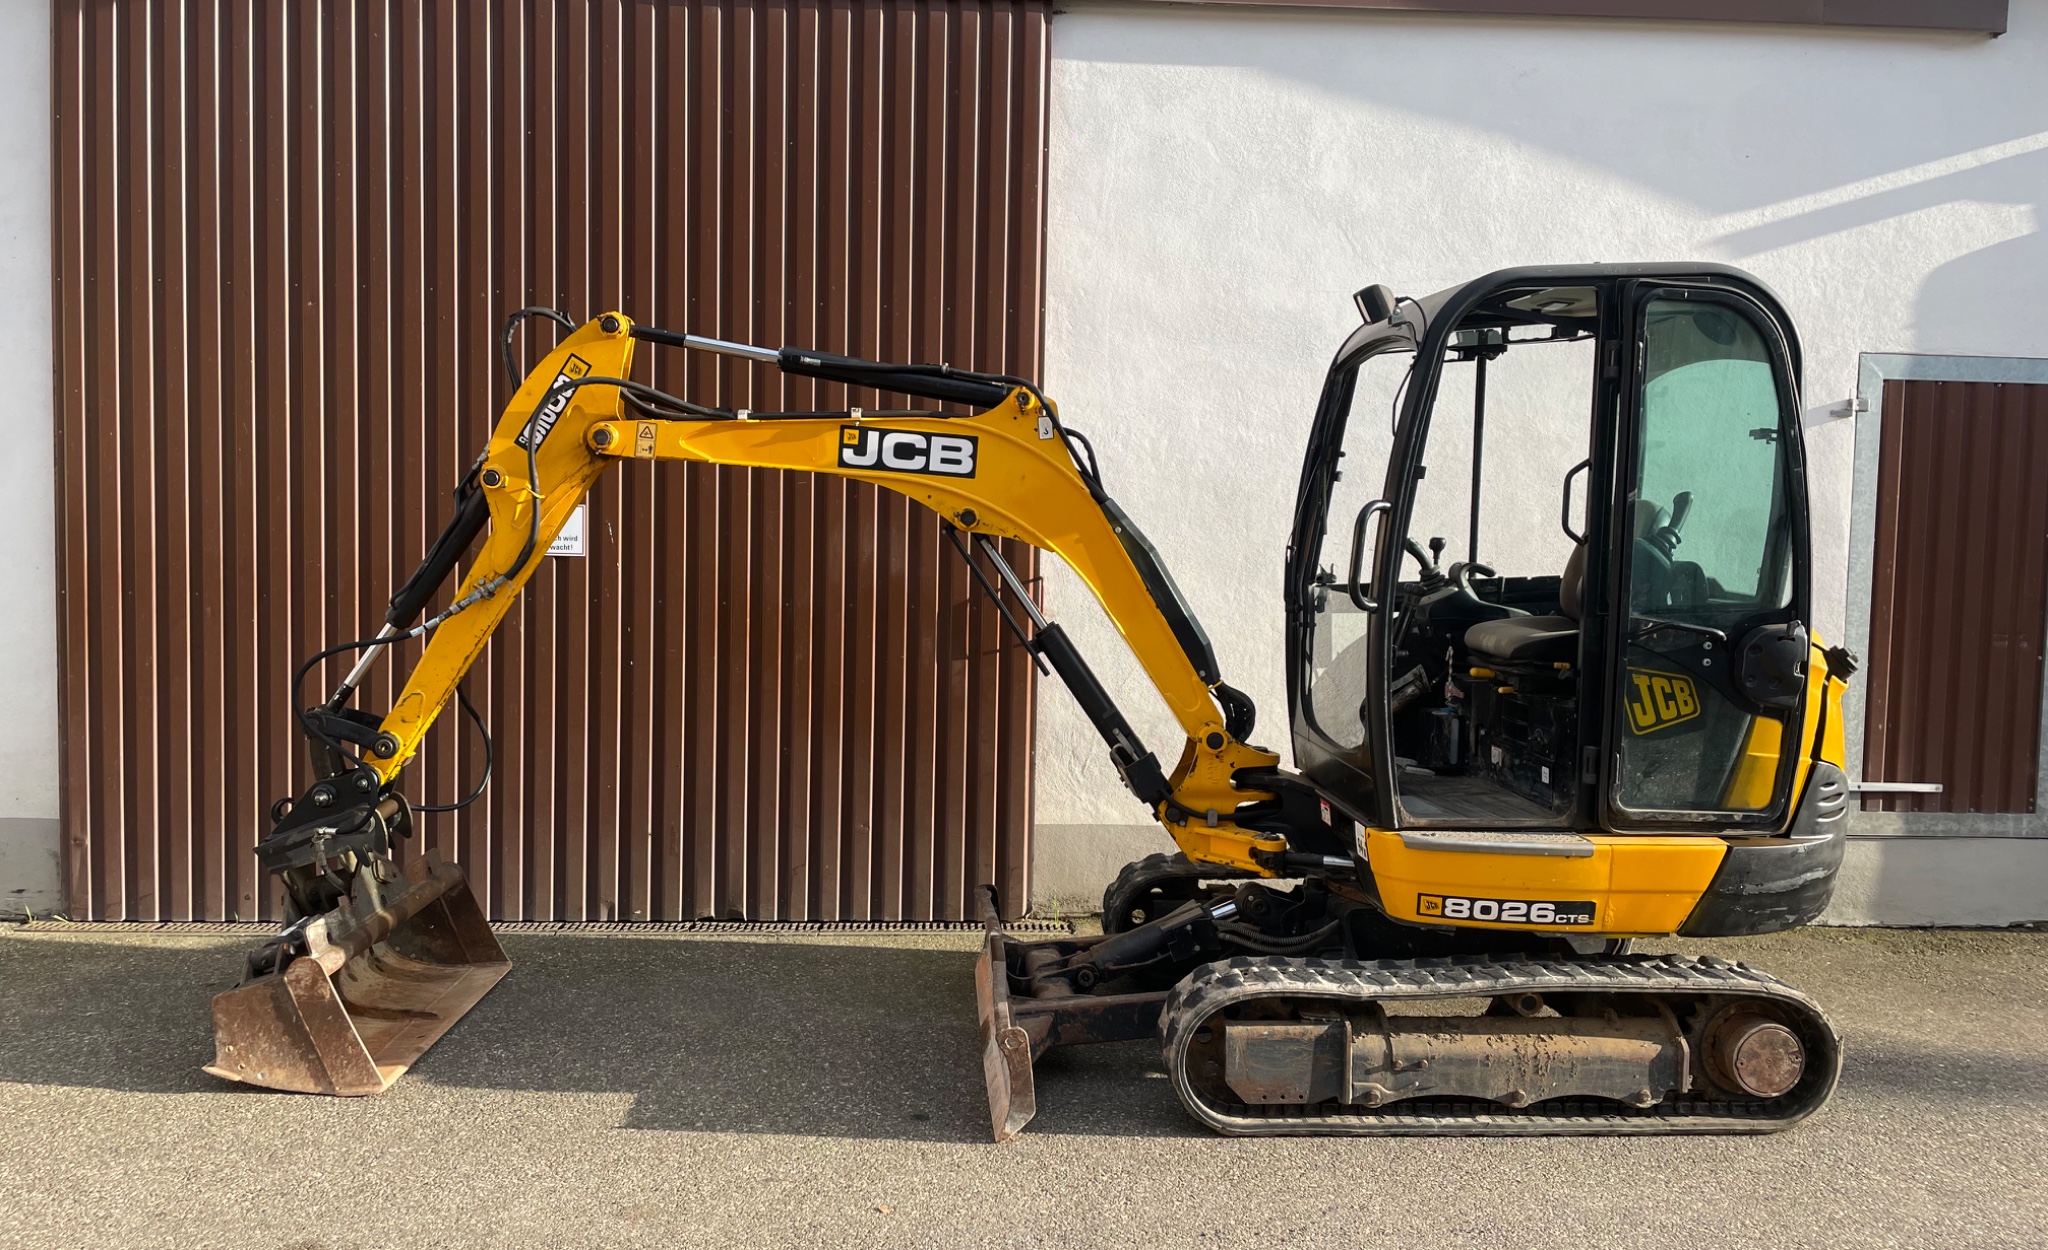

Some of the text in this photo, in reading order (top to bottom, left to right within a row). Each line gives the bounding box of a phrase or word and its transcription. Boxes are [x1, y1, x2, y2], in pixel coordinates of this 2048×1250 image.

[842, 430, 974, 474] JCB
[1632, 673, 1695, 727] JCB
[1444, 898, 1556, 923] 8026
[1555, 914, 1590, 924] CTS
